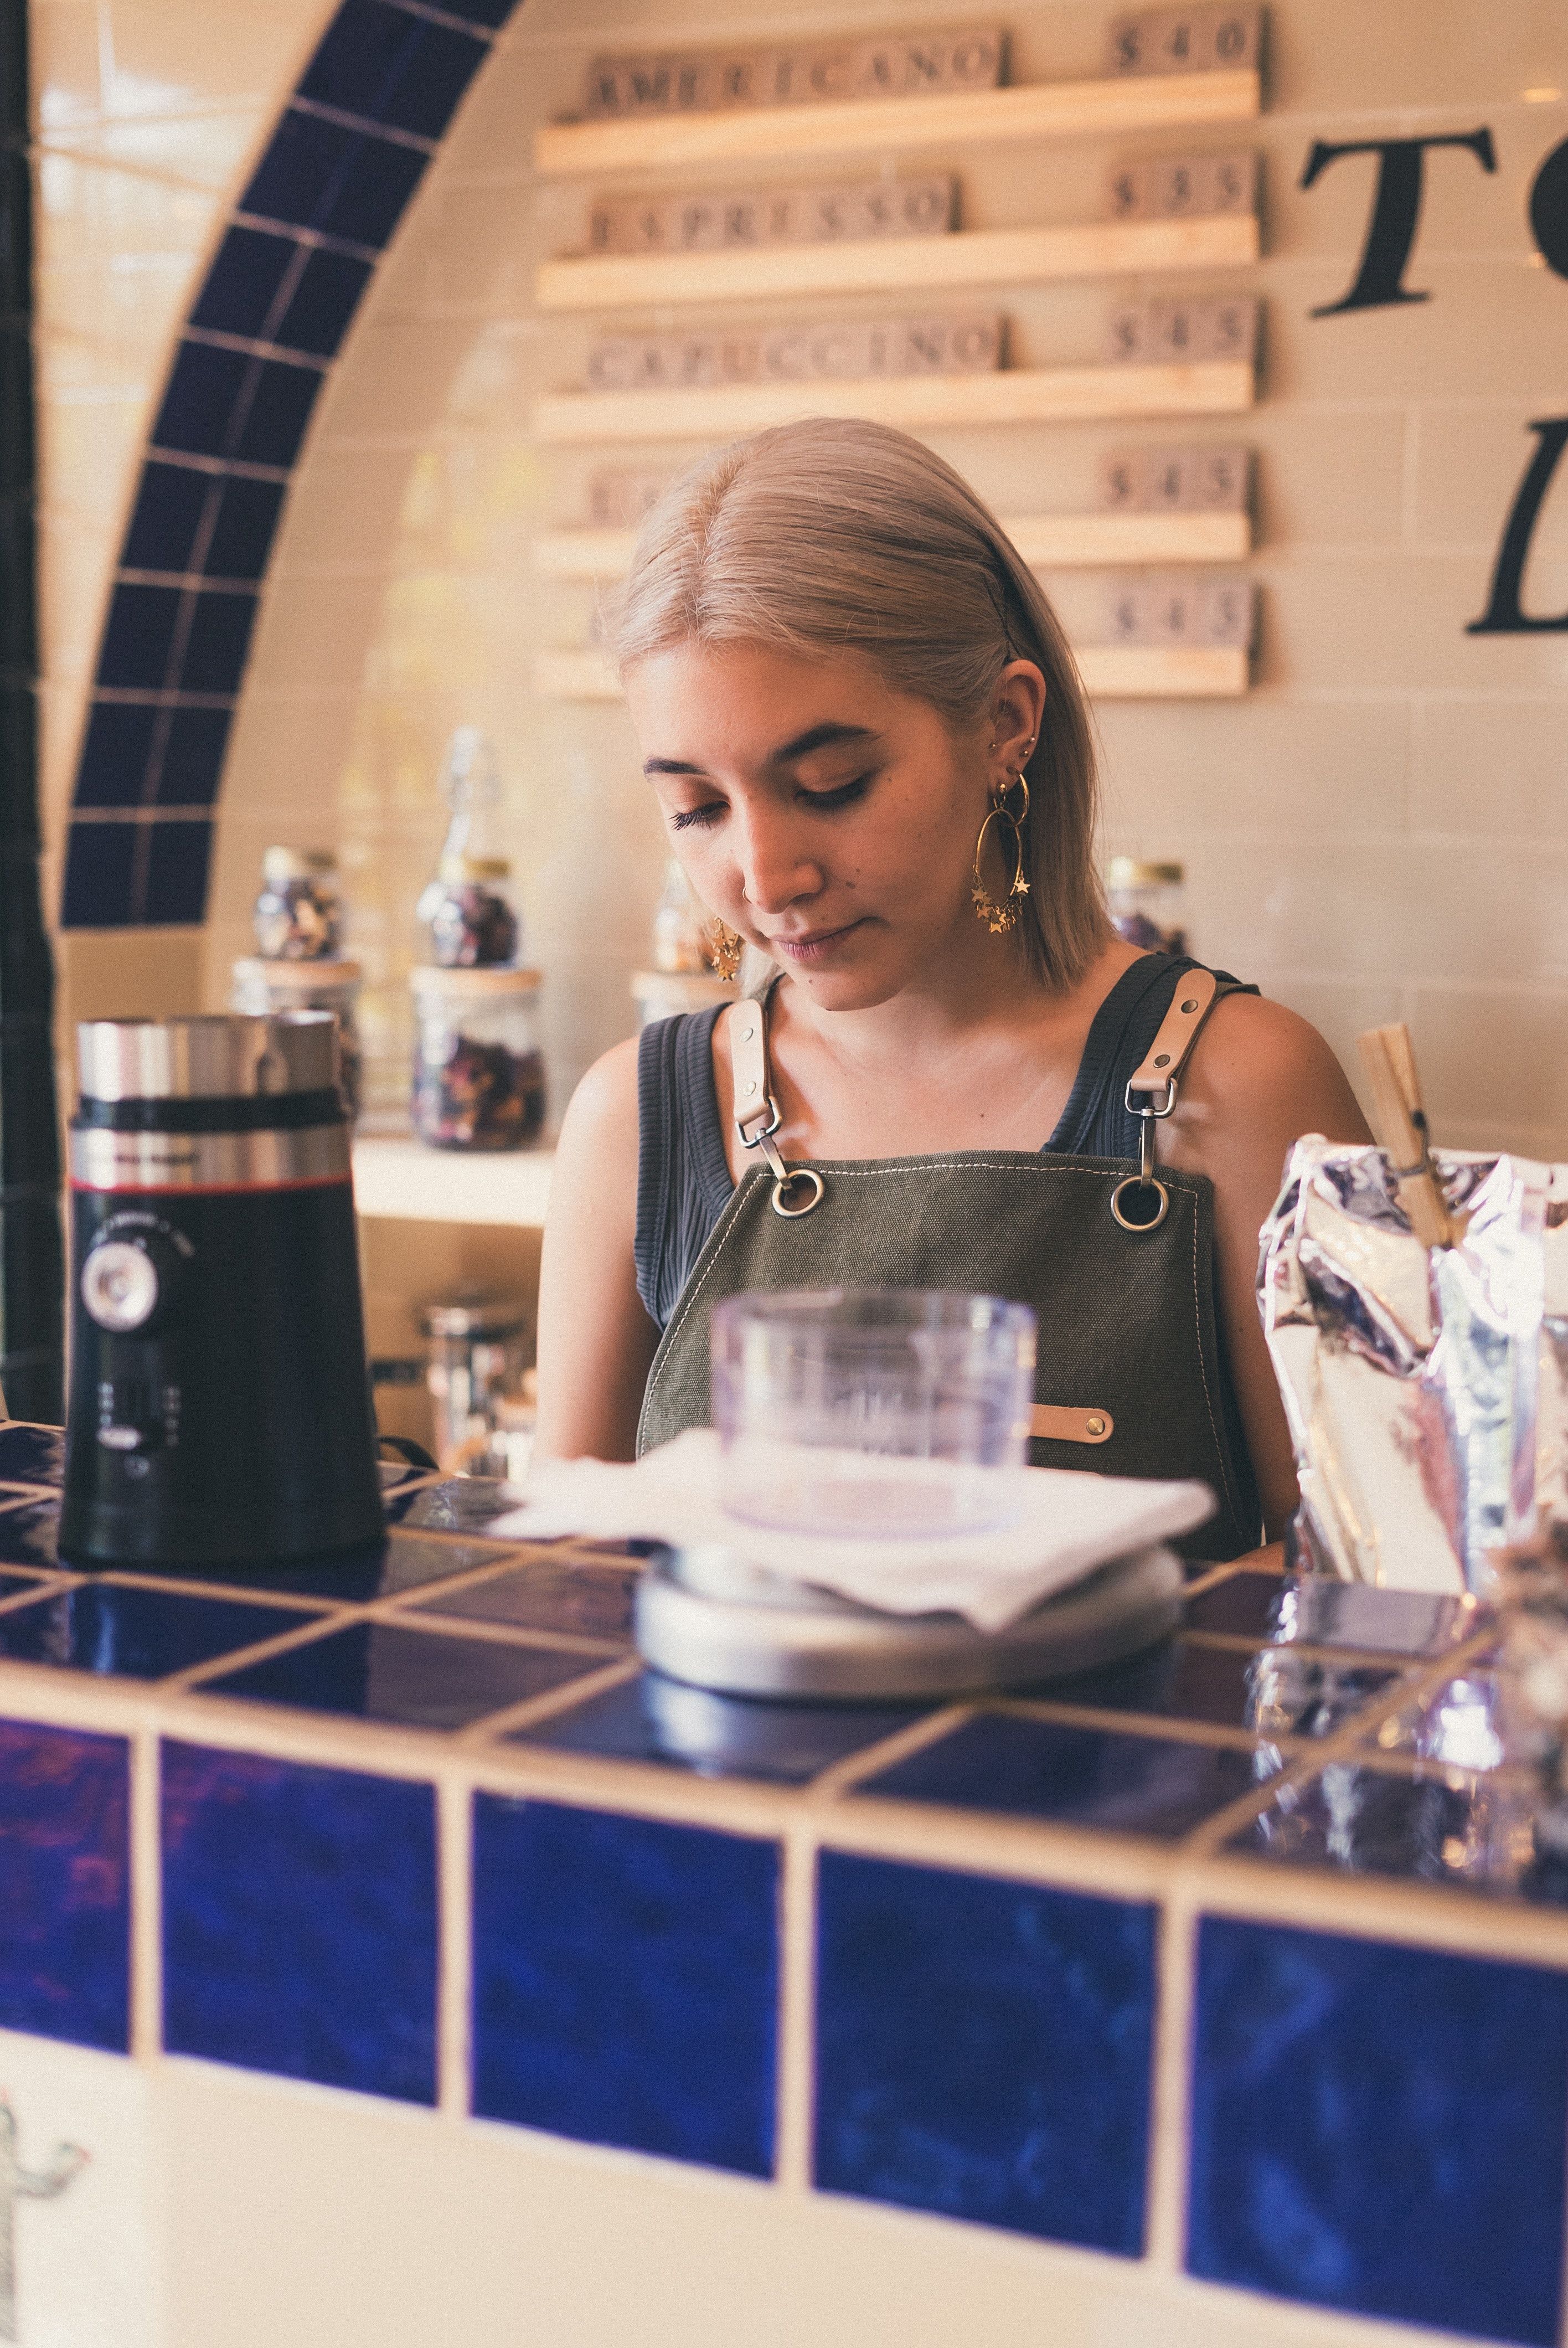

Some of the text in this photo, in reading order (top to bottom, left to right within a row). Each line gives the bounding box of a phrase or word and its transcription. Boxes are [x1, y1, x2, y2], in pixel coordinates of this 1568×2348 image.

[588, 32, 996, 107] AMERICANO
[590, 184, 945, 251] ESPRESSO
[1298, 123, 1568, 319] T
[587, 325, 996, 390] CAPUCCINO
